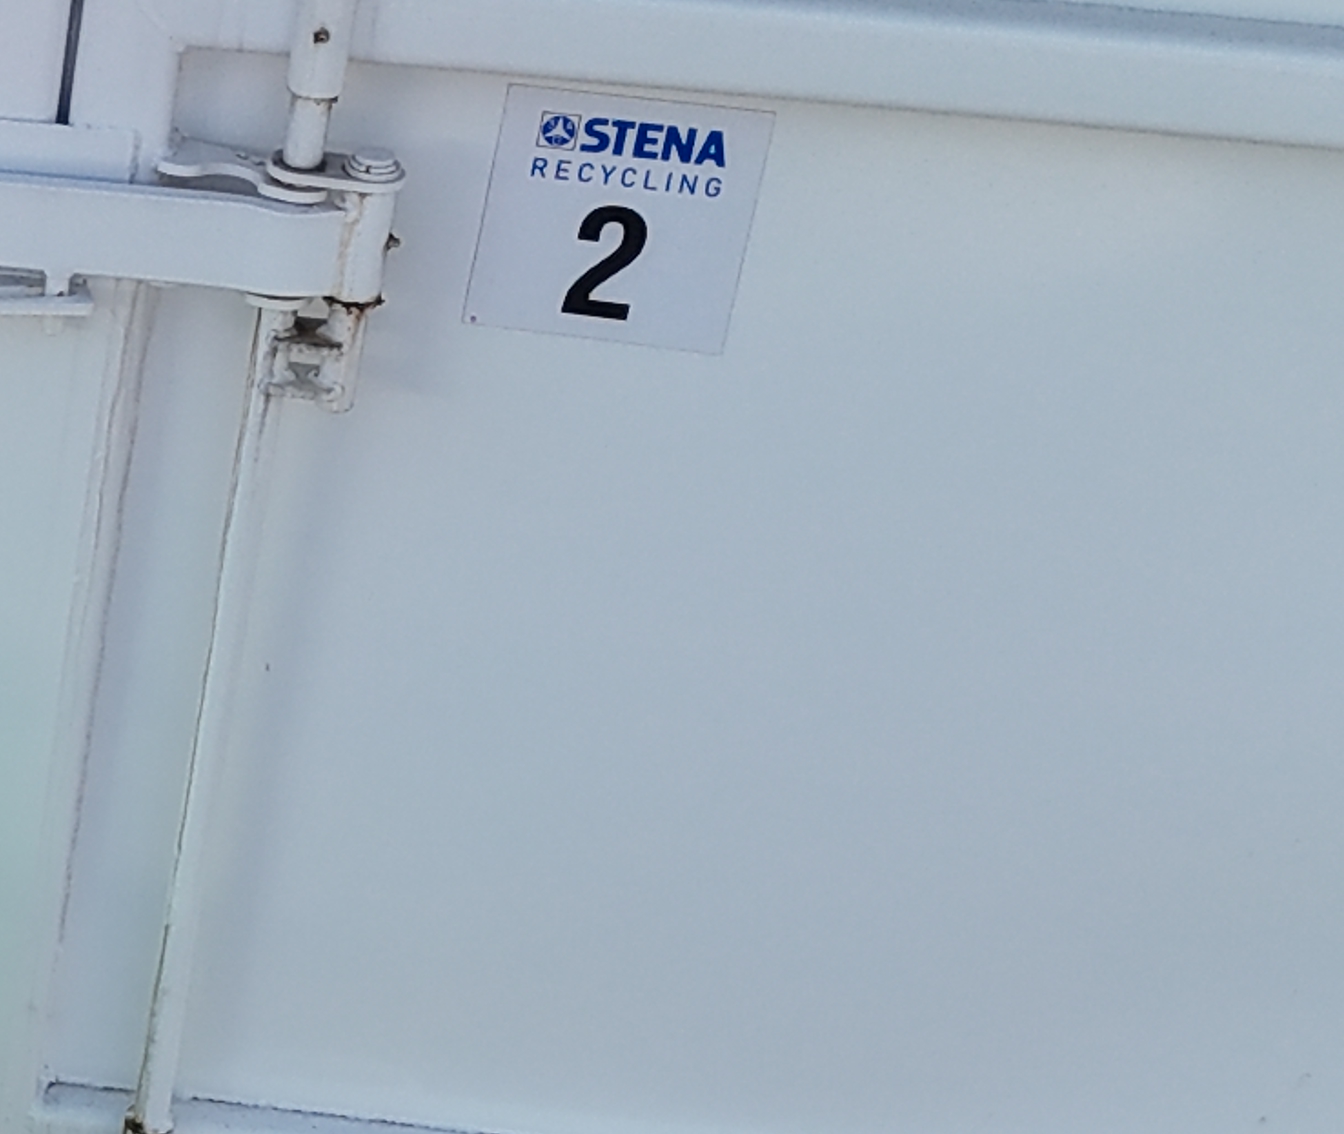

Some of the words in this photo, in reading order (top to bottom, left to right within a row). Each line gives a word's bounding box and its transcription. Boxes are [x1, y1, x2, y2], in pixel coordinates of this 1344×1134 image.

[578, 117, 726, 168] STENA
[530, 156, 723, 198] RECYCLING
[560, 204, 648, 321] 2
